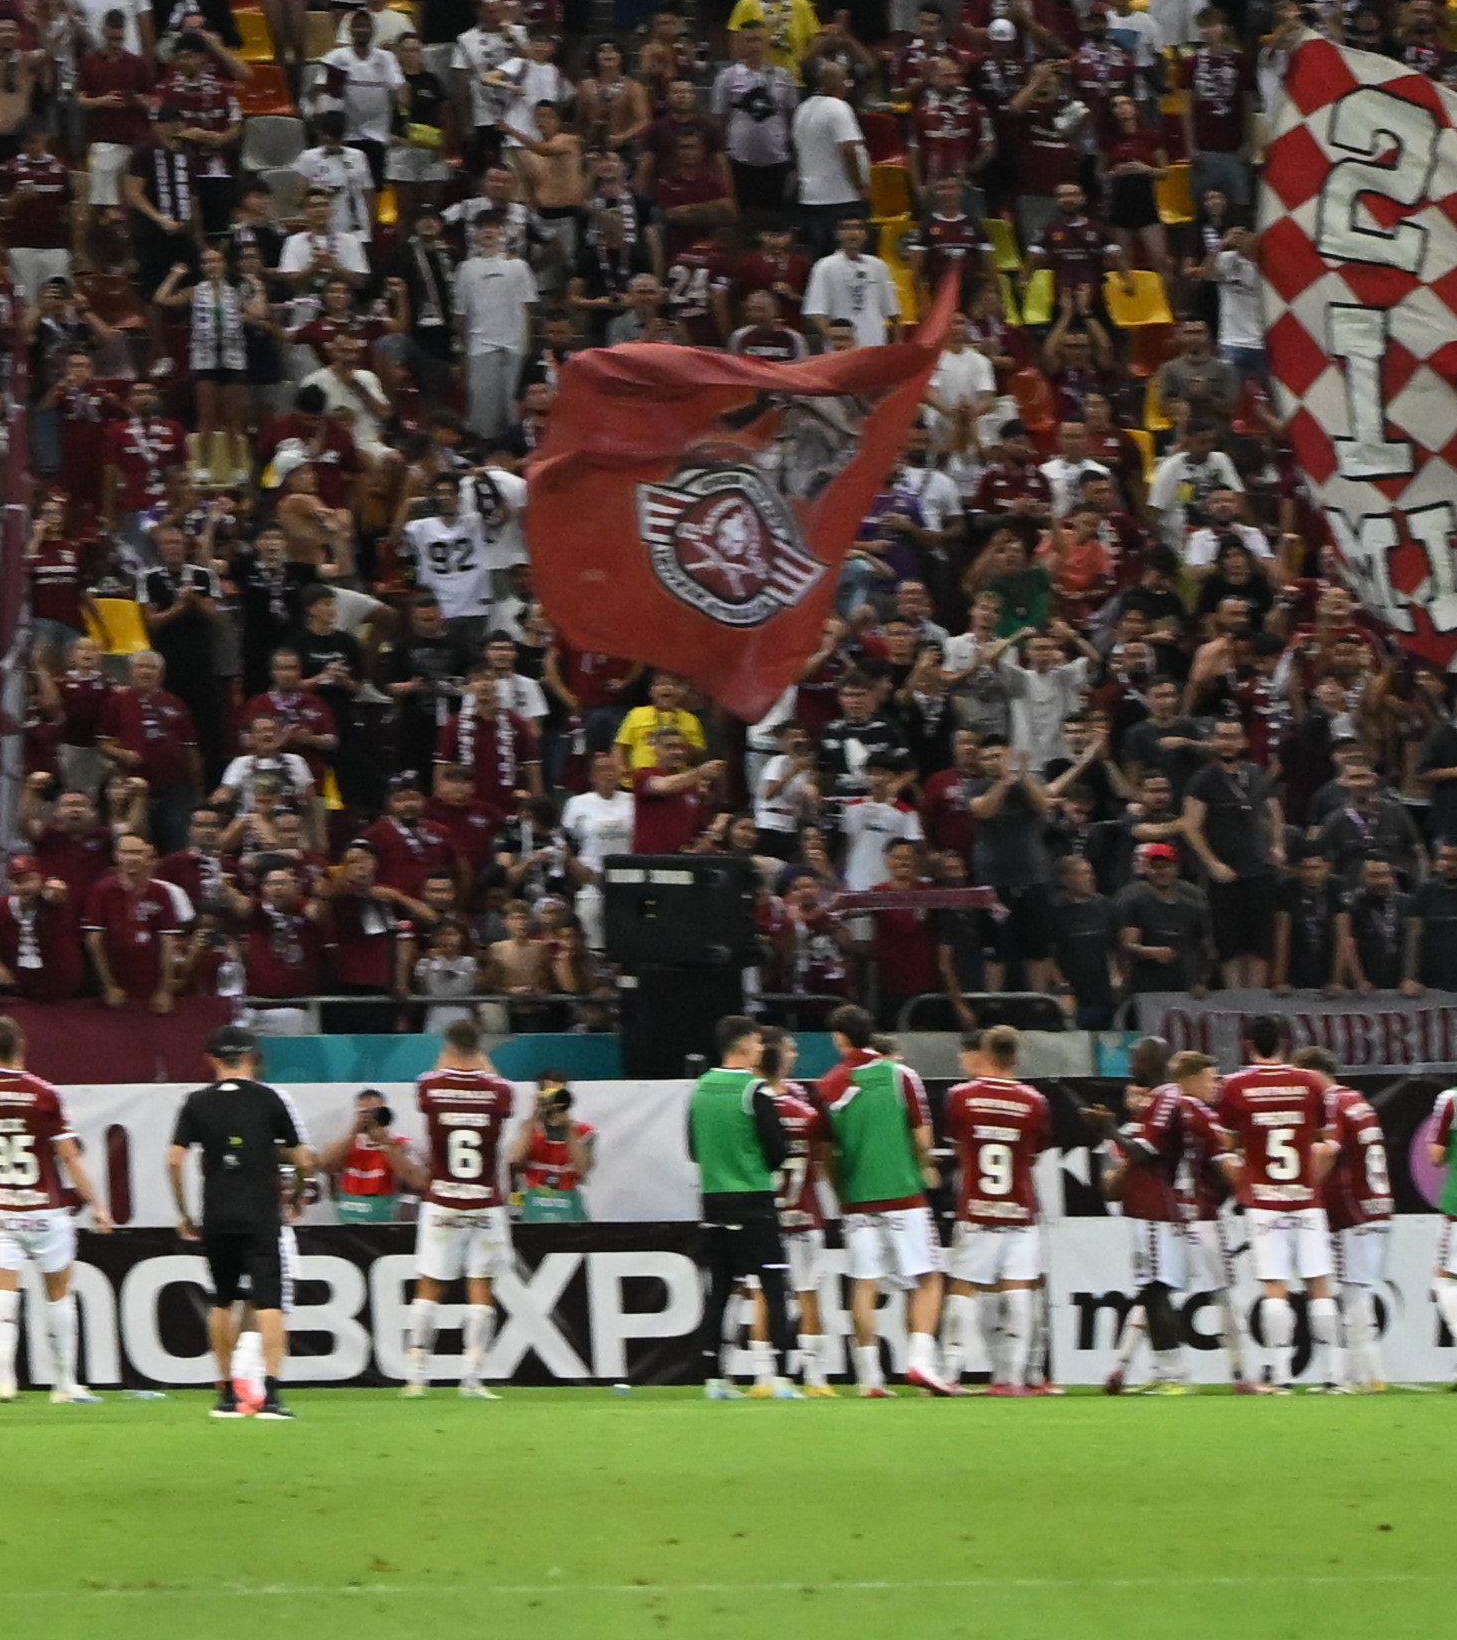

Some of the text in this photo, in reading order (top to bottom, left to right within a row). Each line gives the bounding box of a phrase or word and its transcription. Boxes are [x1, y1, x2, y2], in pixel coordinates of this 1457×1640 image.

[668, 264, 711, 306] 24
[427, 537, 474, 574] 92
[448, 1129, 483, 1169] 6
[978, 1143, 1013, 1195] 9
[1265, 1128, 1301, 1180] 5
